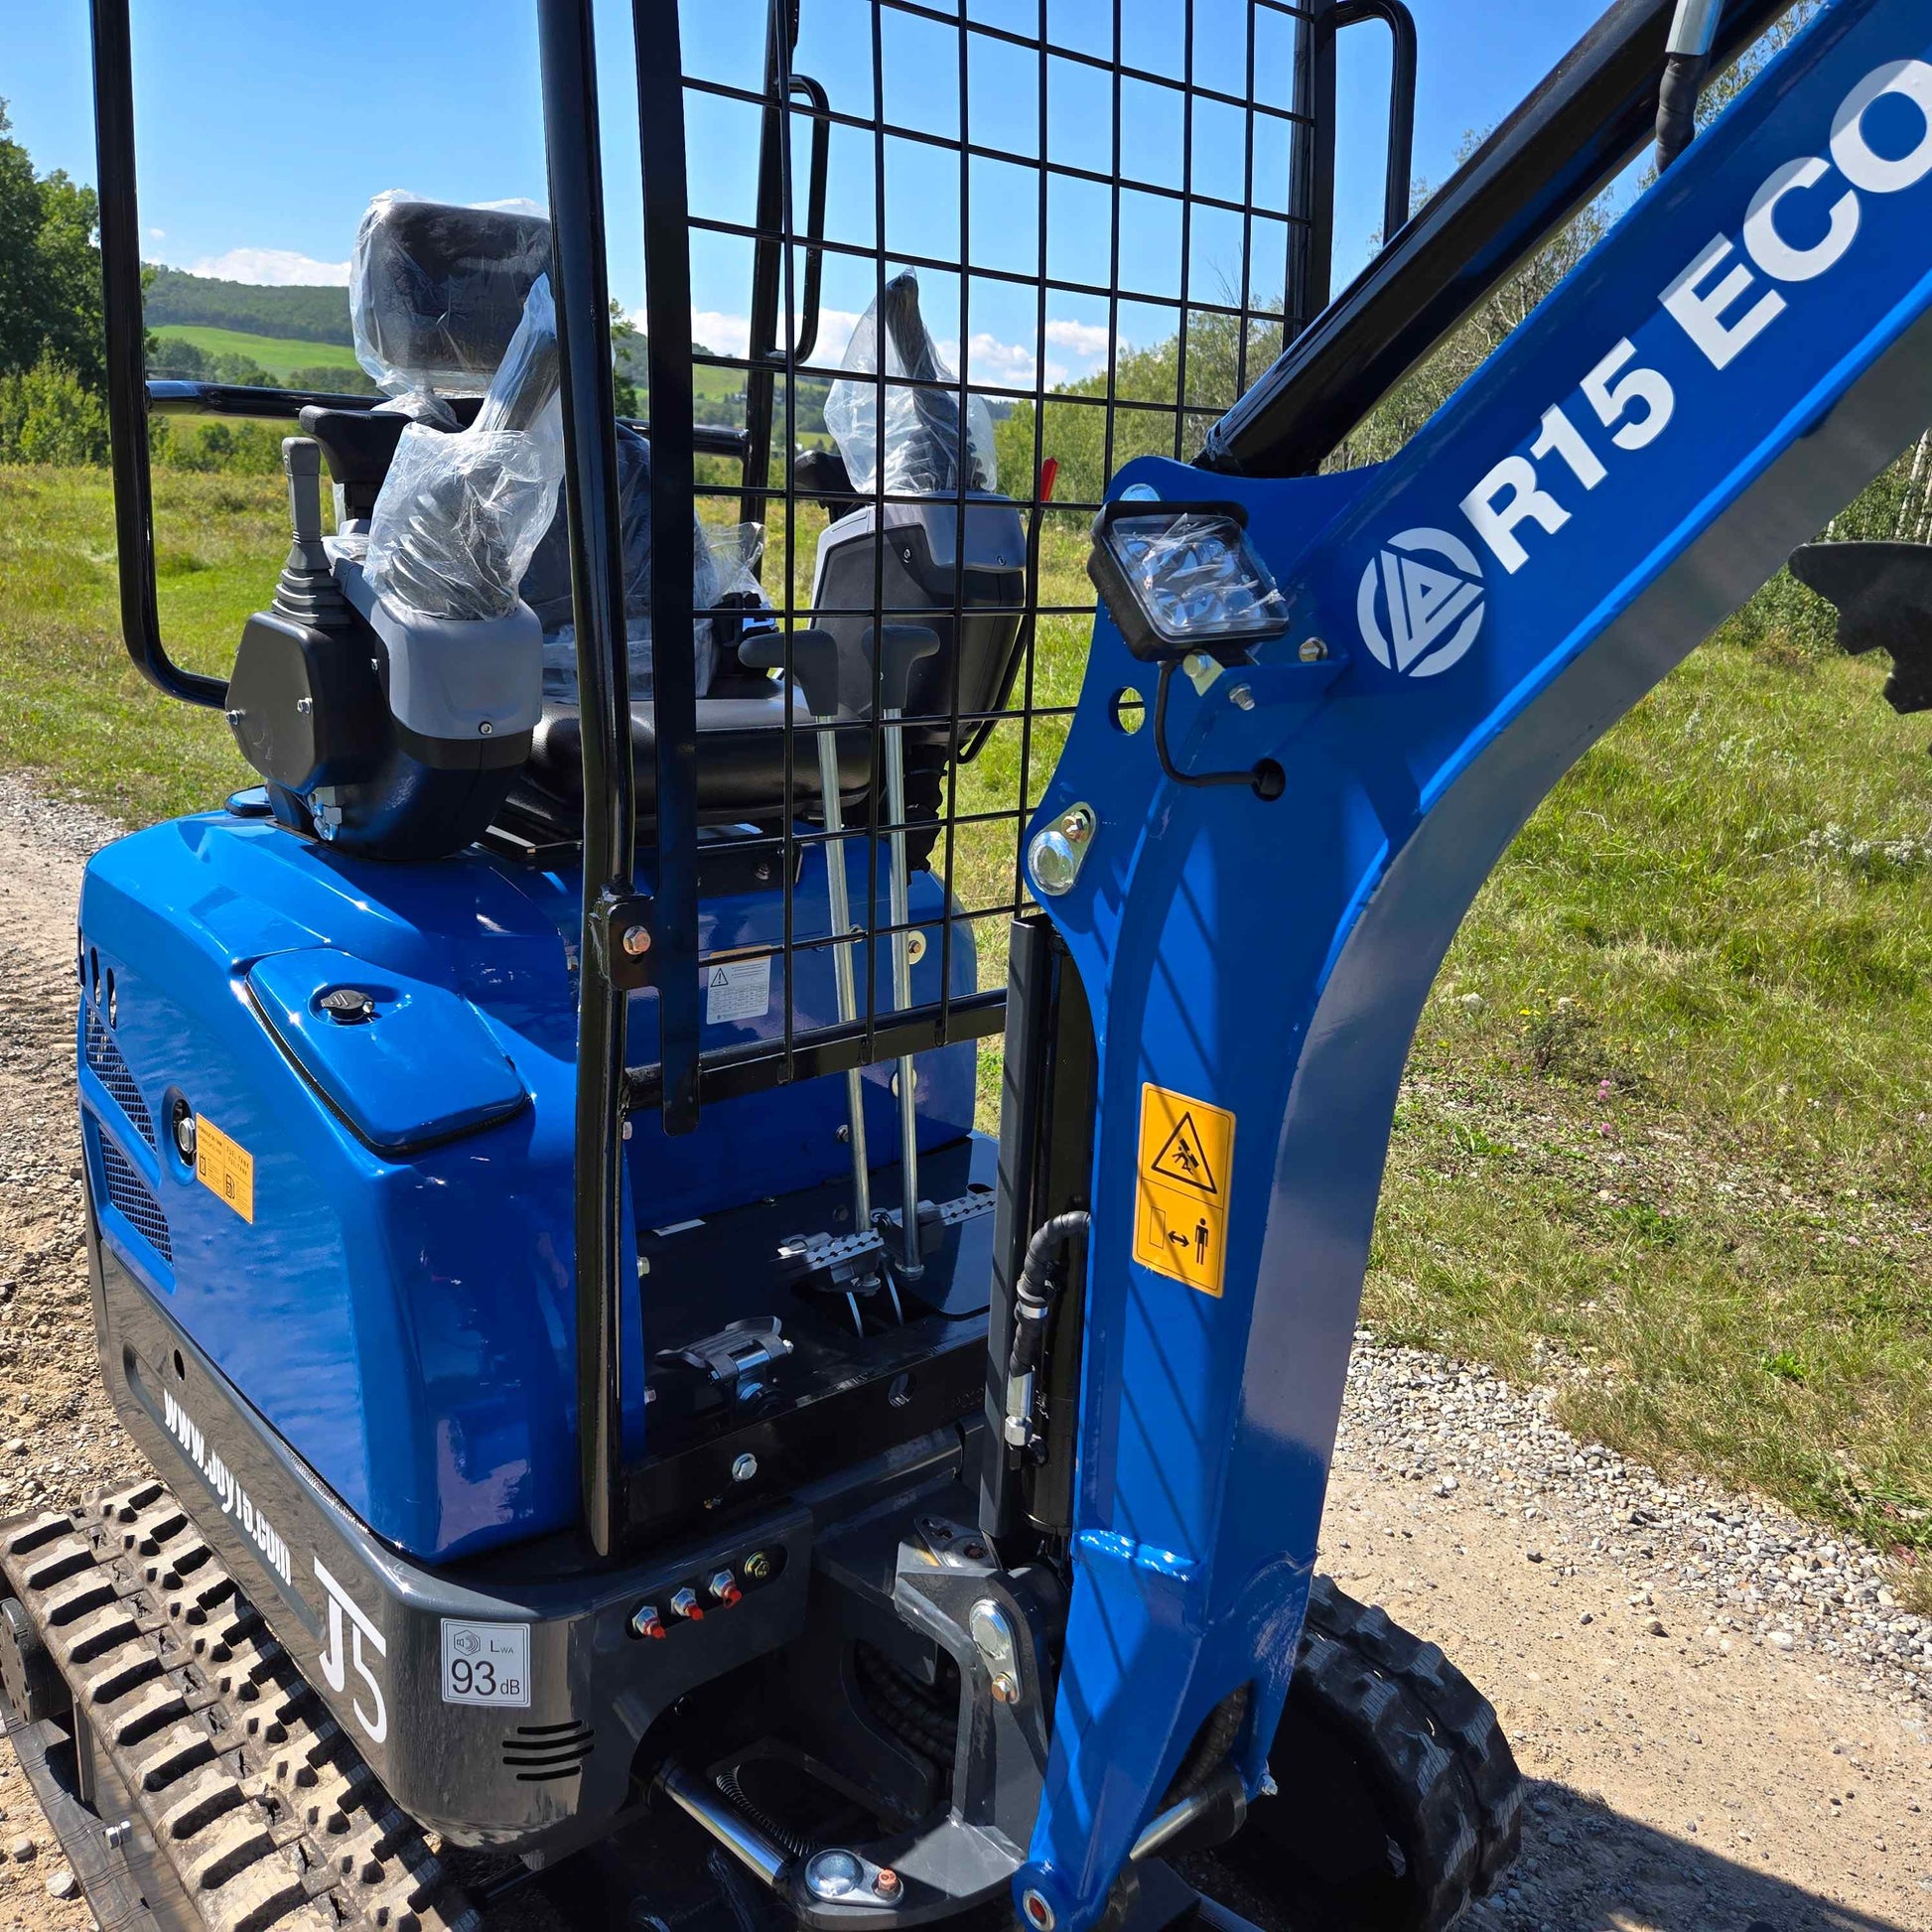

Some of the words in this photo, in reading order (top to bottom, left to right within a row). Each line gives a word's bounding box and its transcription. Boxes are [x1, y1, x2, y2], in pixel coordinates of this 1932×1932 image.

[1458, 337, 1675, 574] R15
[1658, 60, 1932, 371] ECO
[451, 1658, 497, 1696] 93
[499, 1678, 520, 1696] dB
